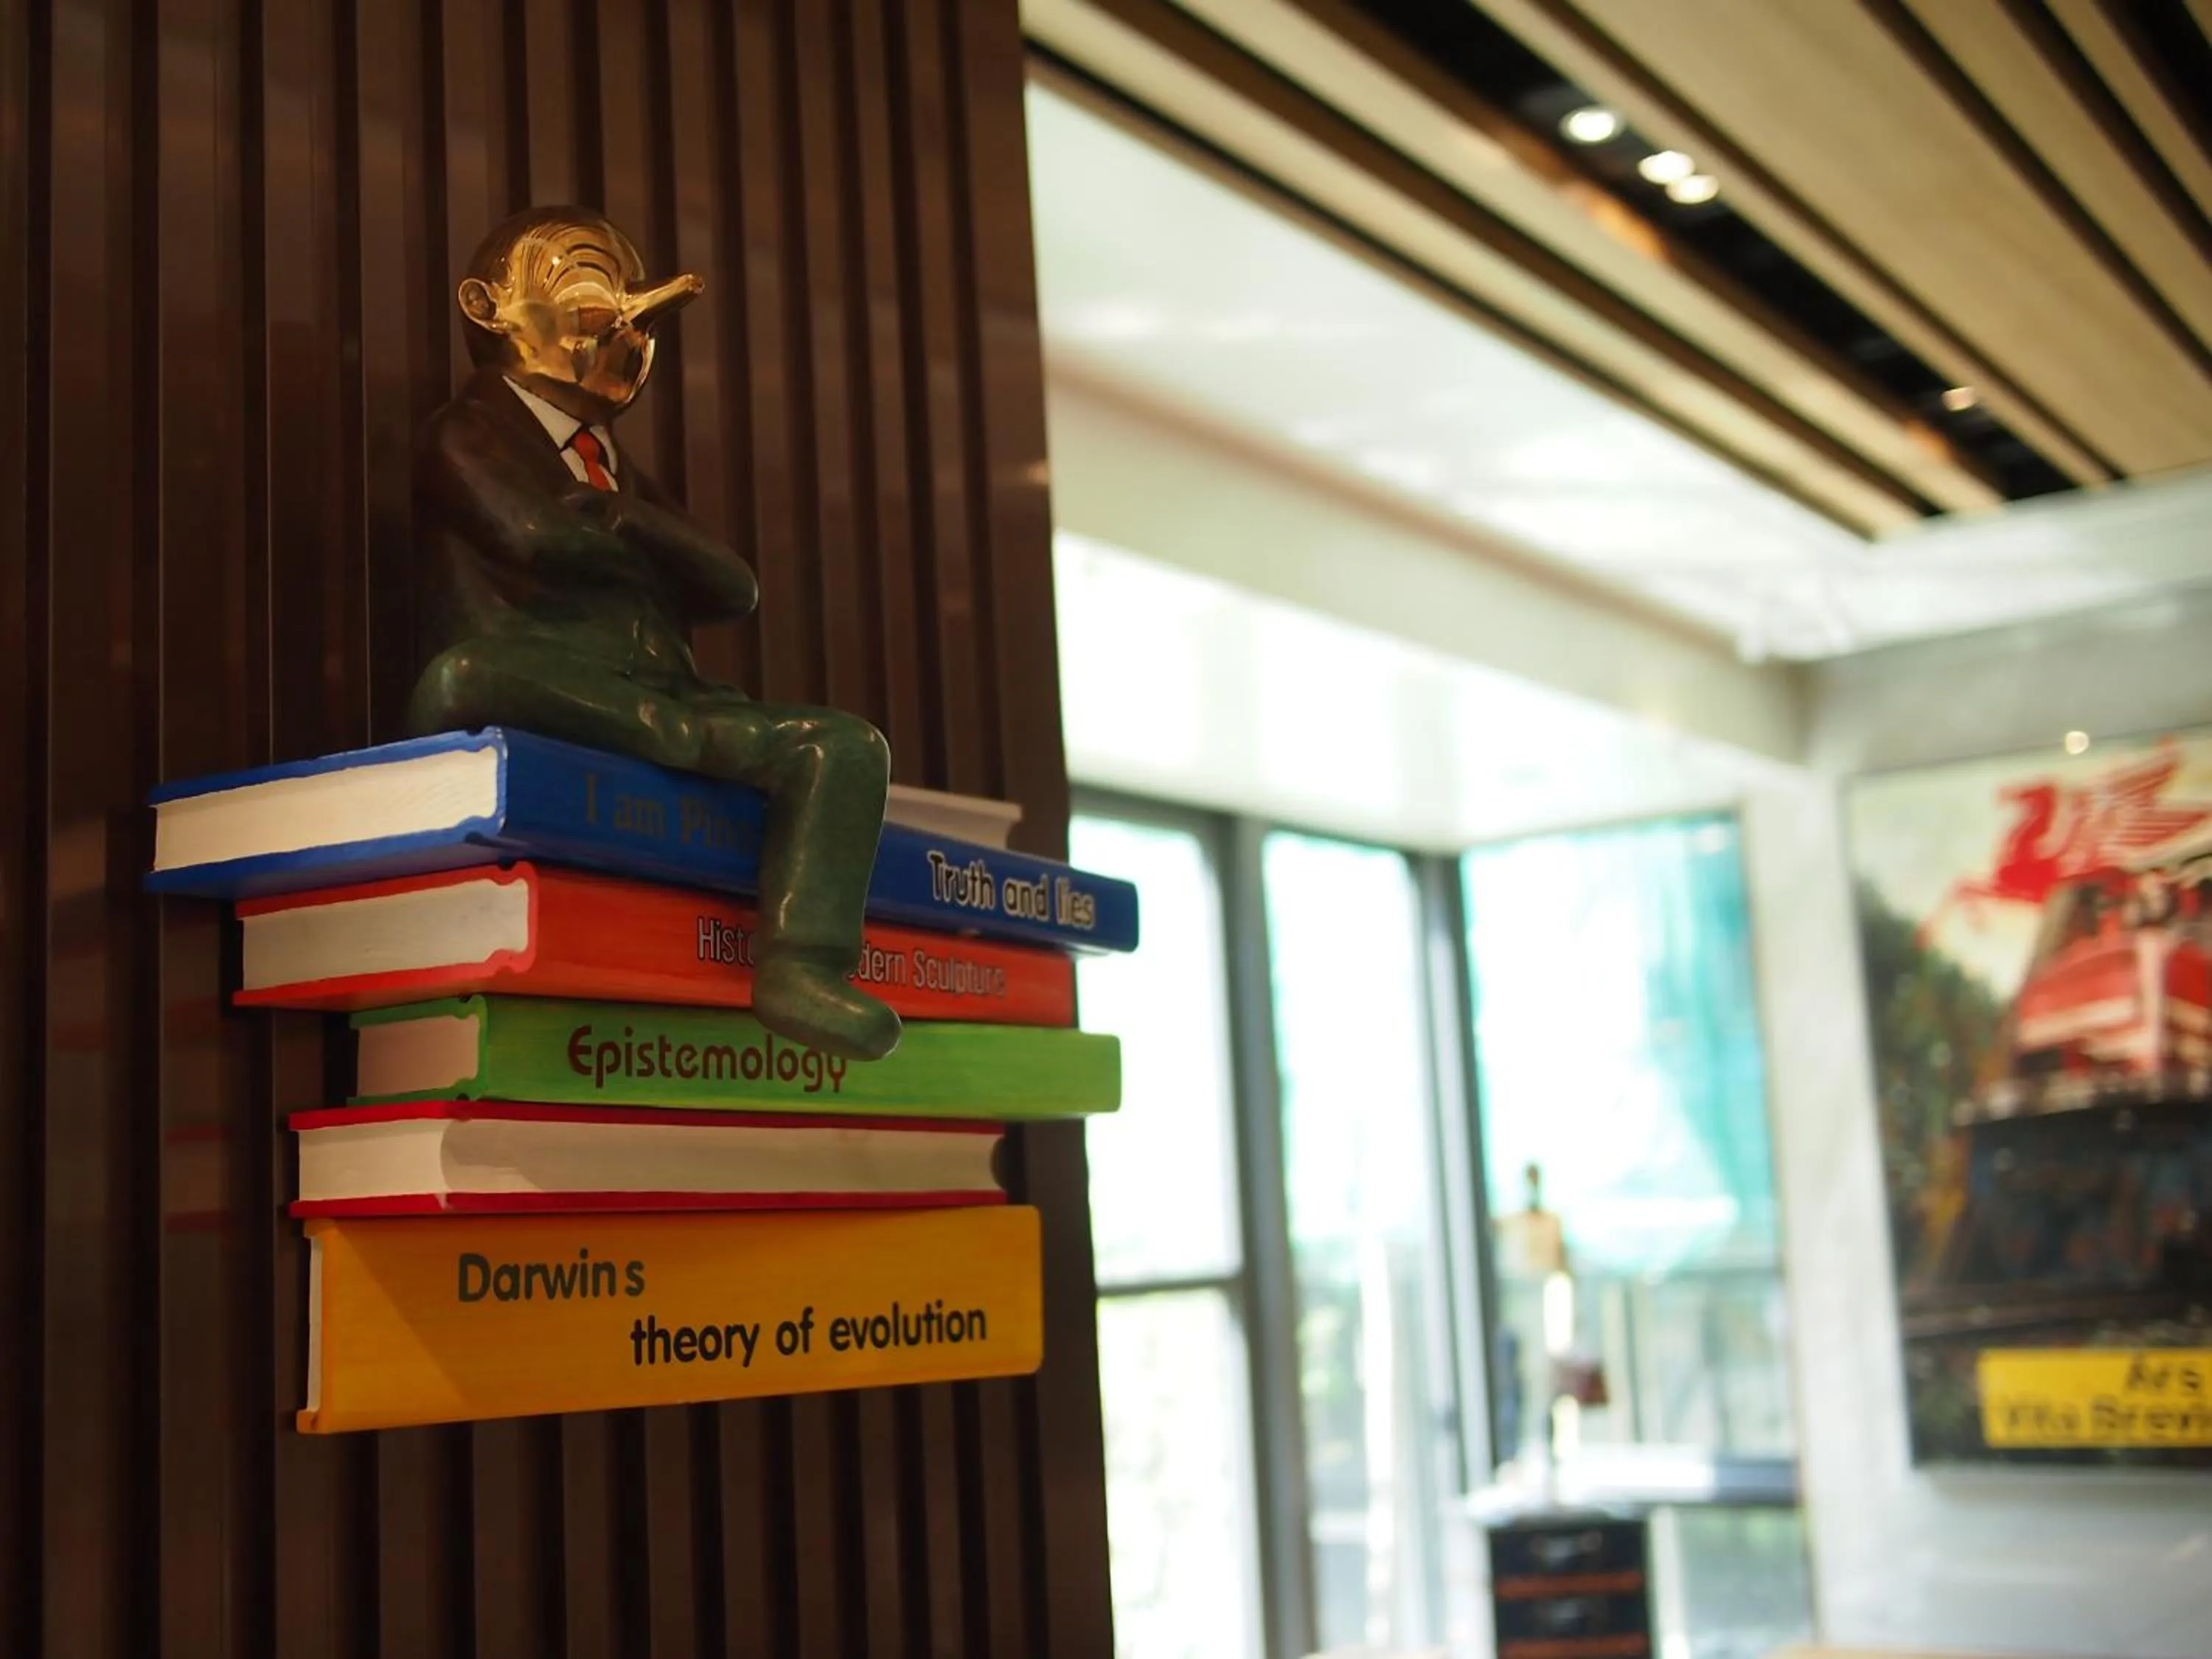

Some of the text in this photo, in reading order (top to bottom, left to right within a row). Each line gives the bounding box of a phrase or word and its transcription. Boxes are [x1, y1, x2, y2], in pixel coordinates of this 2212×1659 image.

[612, 792, 665, 838] am
[927, 850, 1096, 931] Truth and lies
[848, 941, 906, 987] dern
[913, 948, 1007, 997] Sculpture
[566, 1025, 846, 1093] Epistemology
[630, 1299, 987, 1368] theory of evolution
